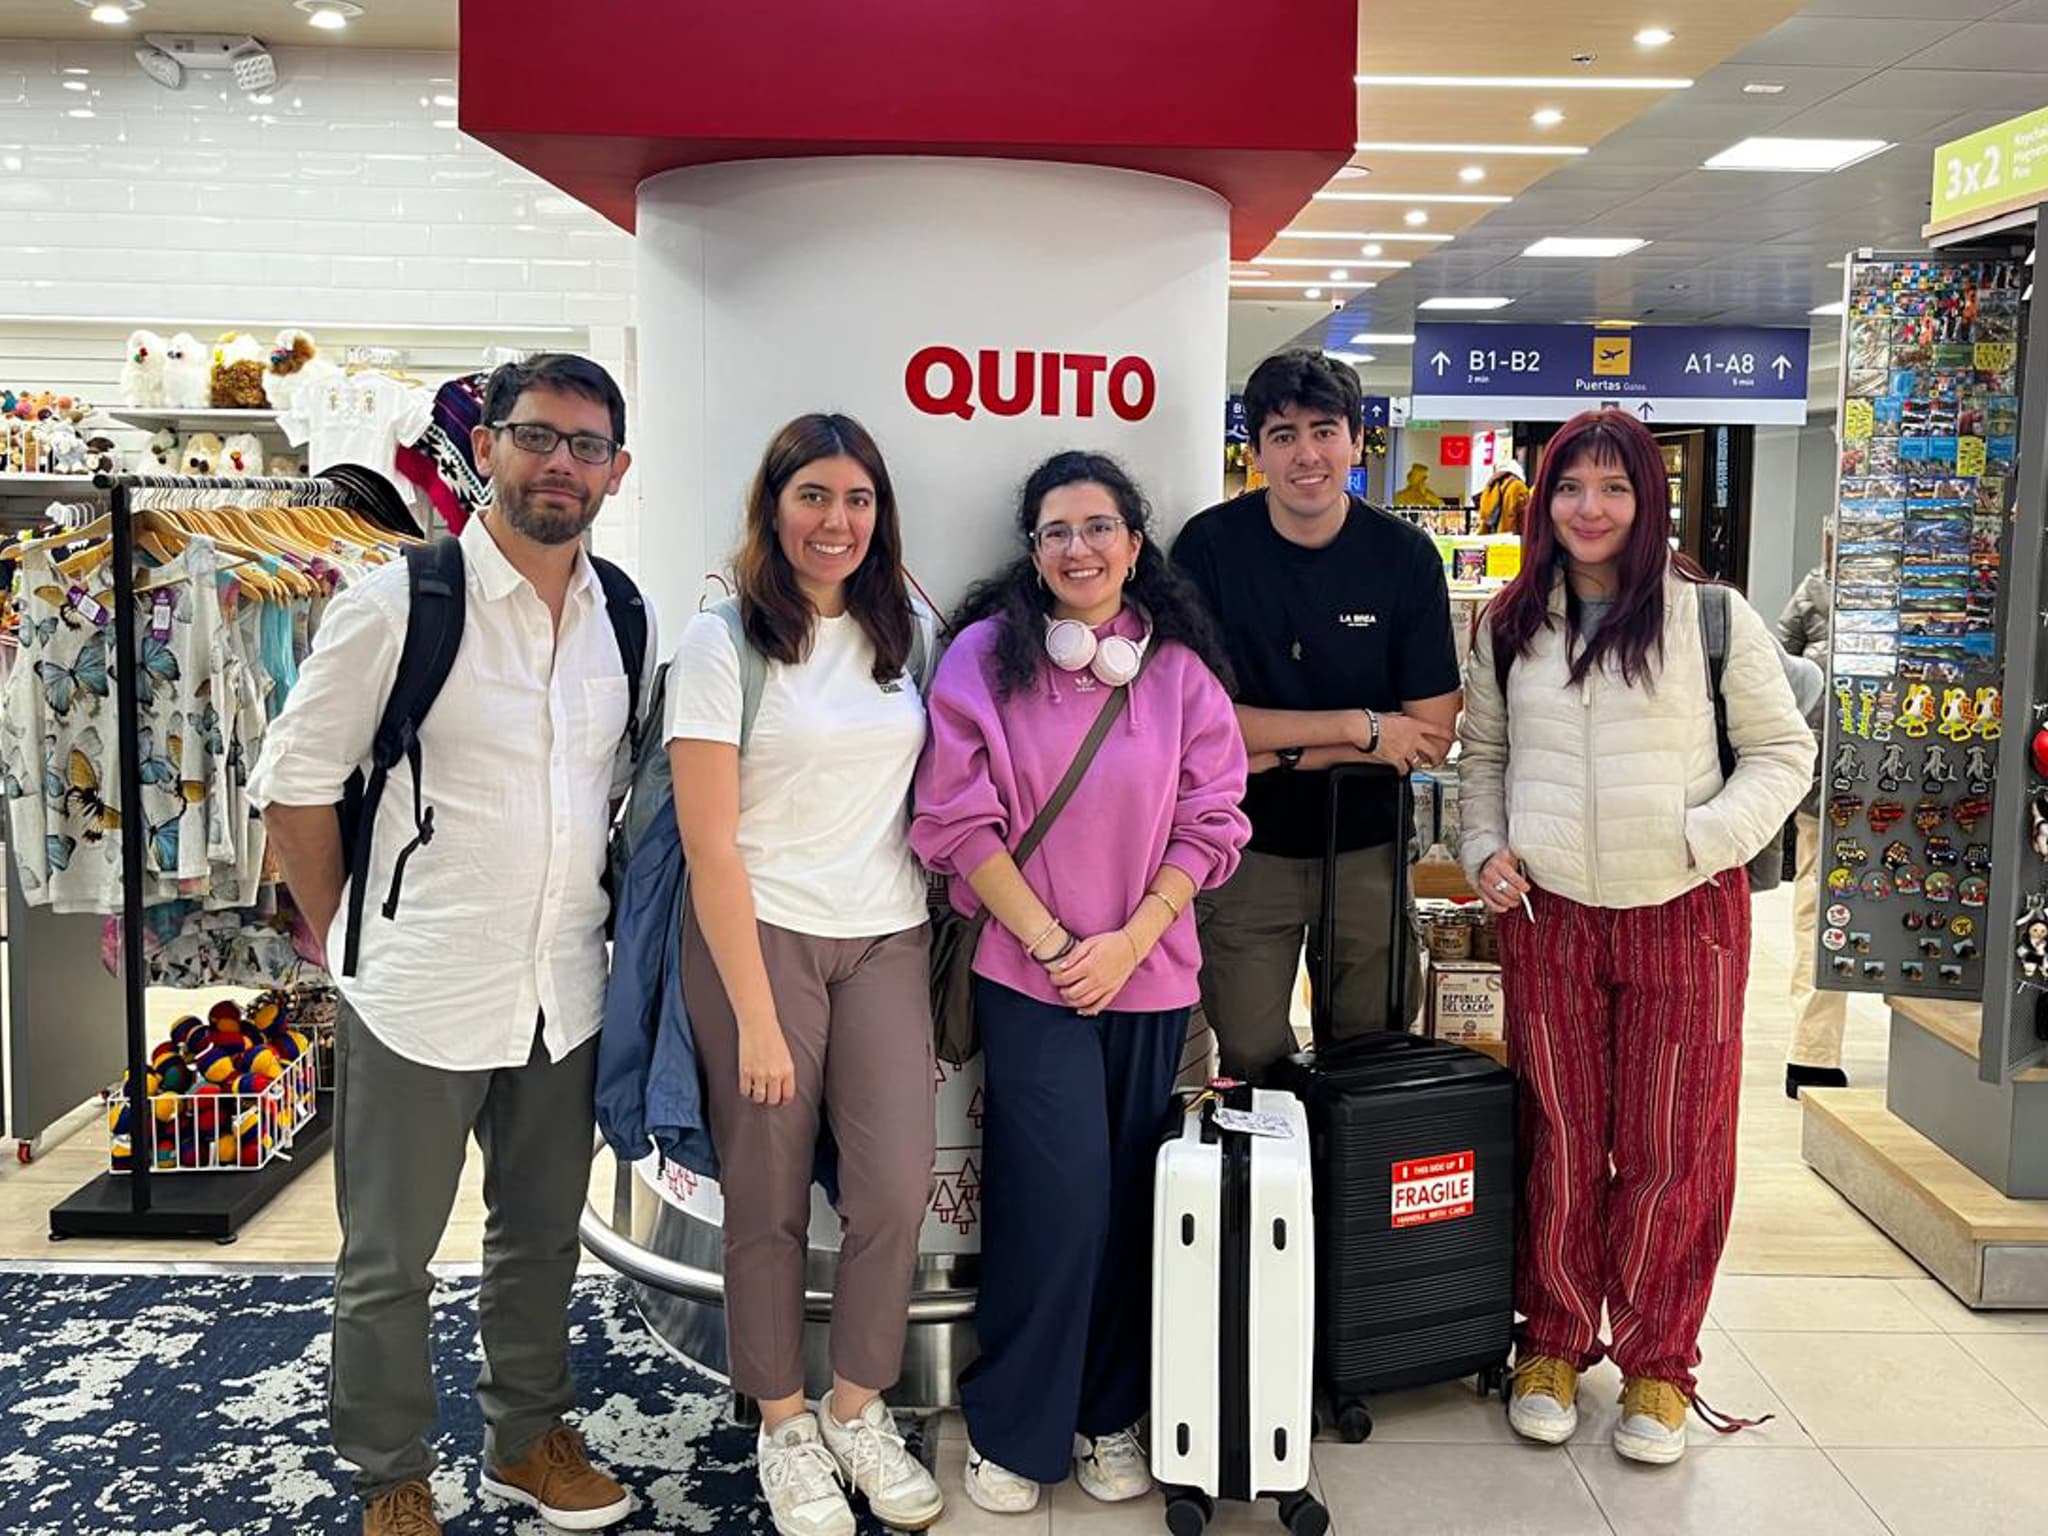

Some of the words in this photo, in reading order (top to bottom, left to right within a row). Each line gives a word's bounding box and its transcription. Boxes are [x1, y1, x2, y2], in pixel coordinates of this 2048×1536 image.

[1945, 145, 2000, 201] 3x2
[1470, 350, 1540, 372] B1-B2
[1684, 353, 1754, 374] A1-A8
[905, 346, 1155, 421] QUITO
[1575, 378, 1621, 391] Puertas
[1395, 1178, 1469, 1208] FRAGILE
